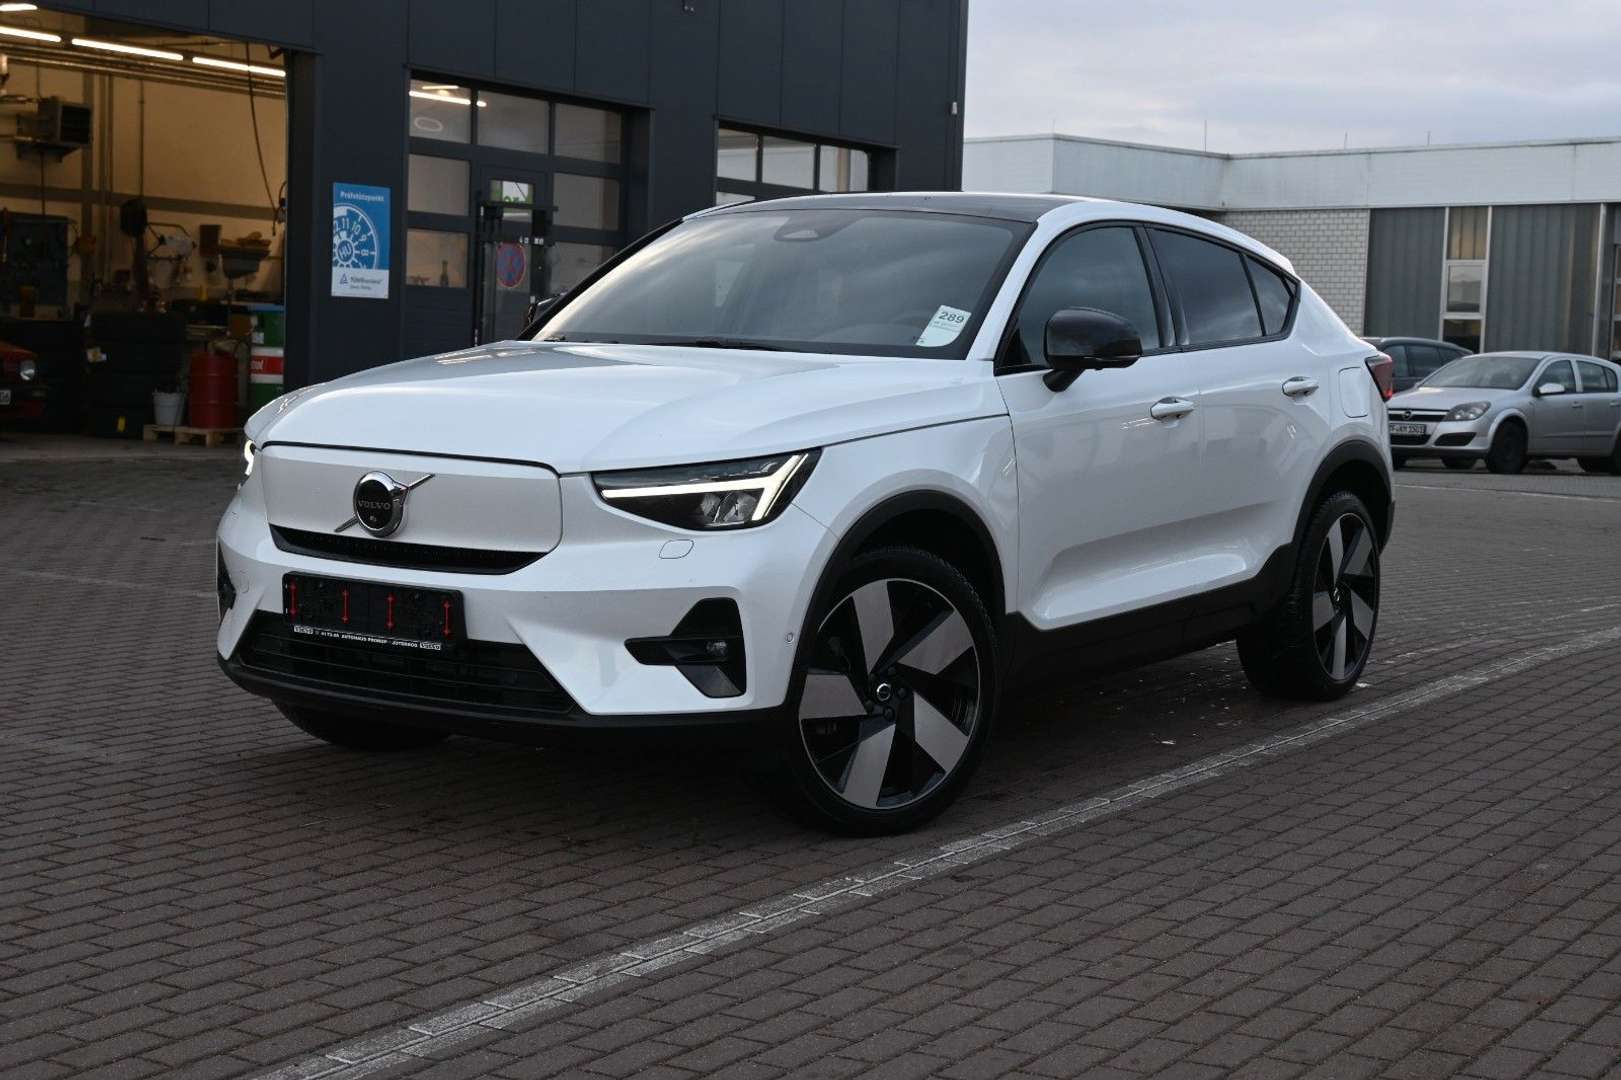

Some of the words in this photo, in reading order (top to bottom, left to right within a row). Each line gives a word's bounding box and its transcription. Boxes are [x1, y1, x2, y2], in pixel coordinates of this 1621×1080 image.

[351, 221, 361, 235] 10
[938, 312, 964, 324] 289
[358, 500, 391, 510] VOLVO
